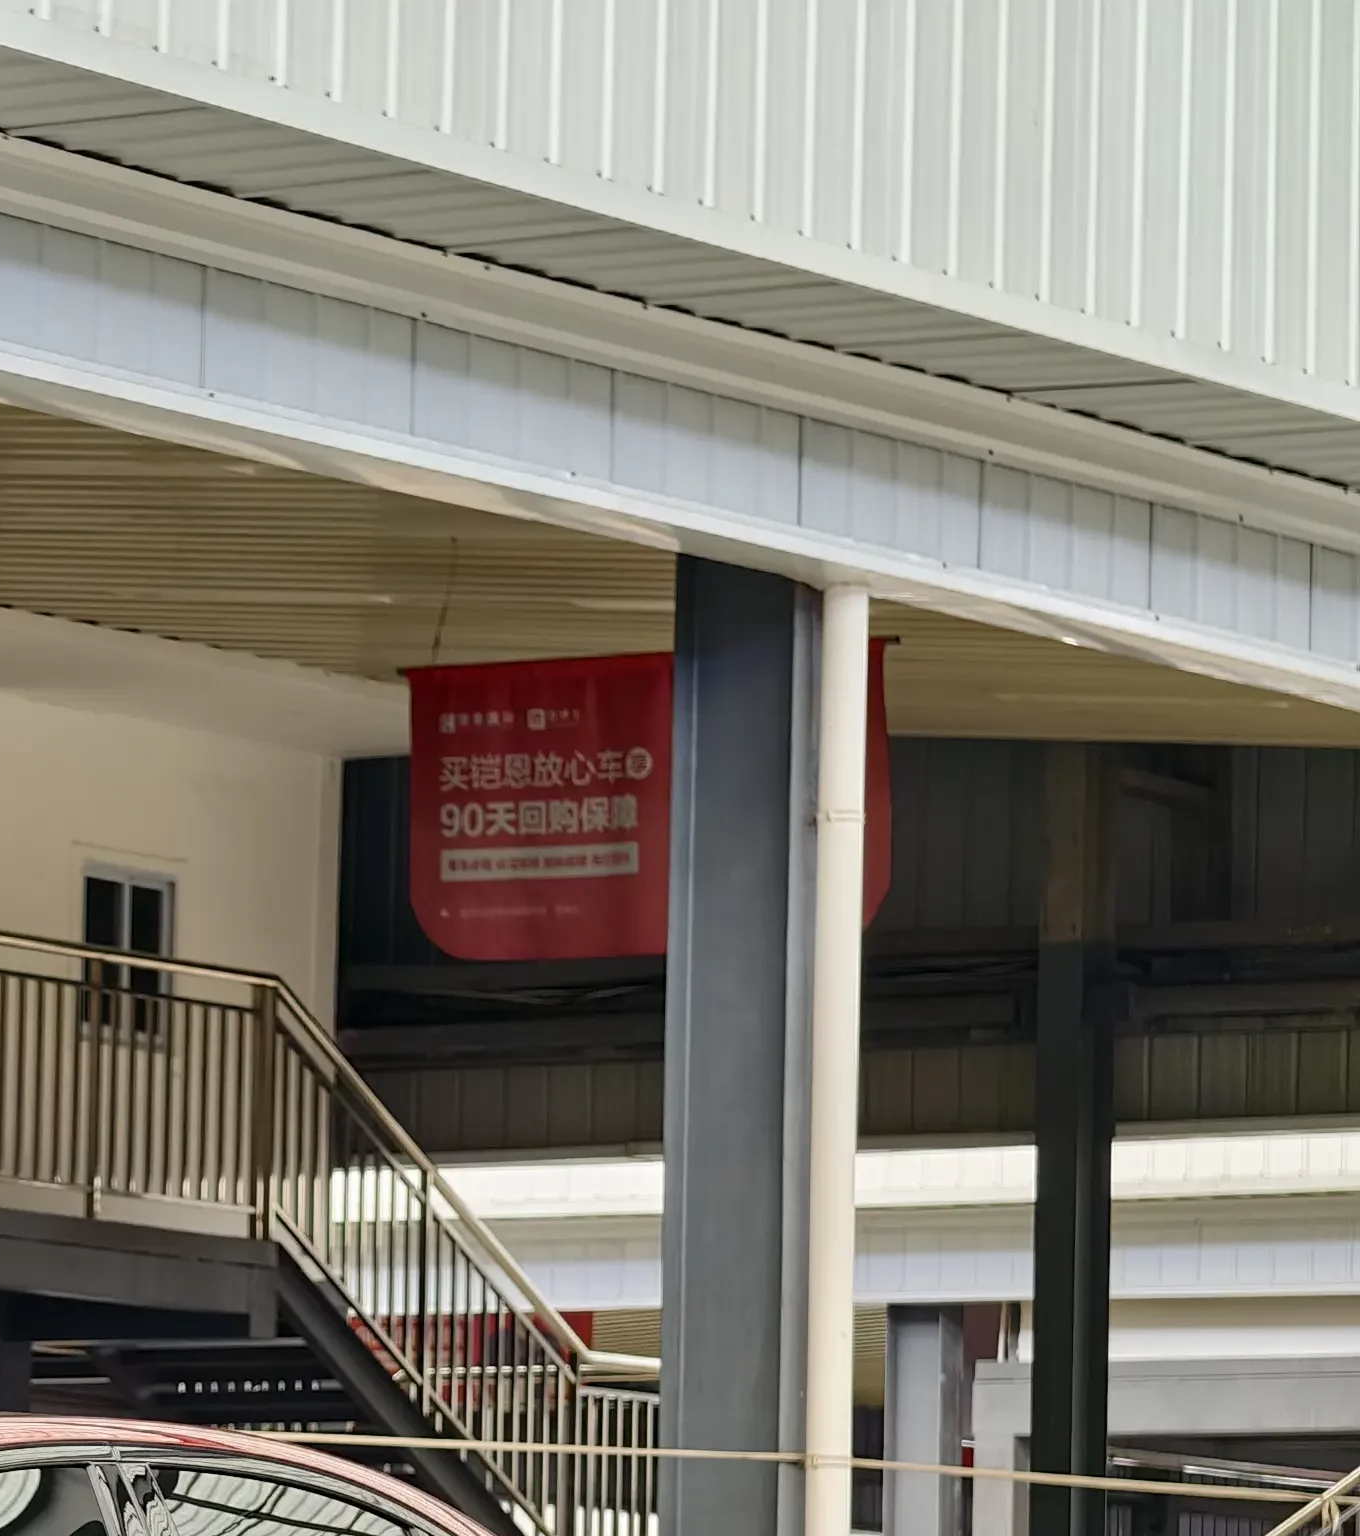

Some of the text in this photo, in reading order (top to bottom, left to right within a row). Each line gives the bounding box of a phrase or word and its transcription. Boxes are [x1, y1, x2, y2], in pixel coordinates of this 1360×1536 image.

[439, 795, 639, 838] 90天回购保障
